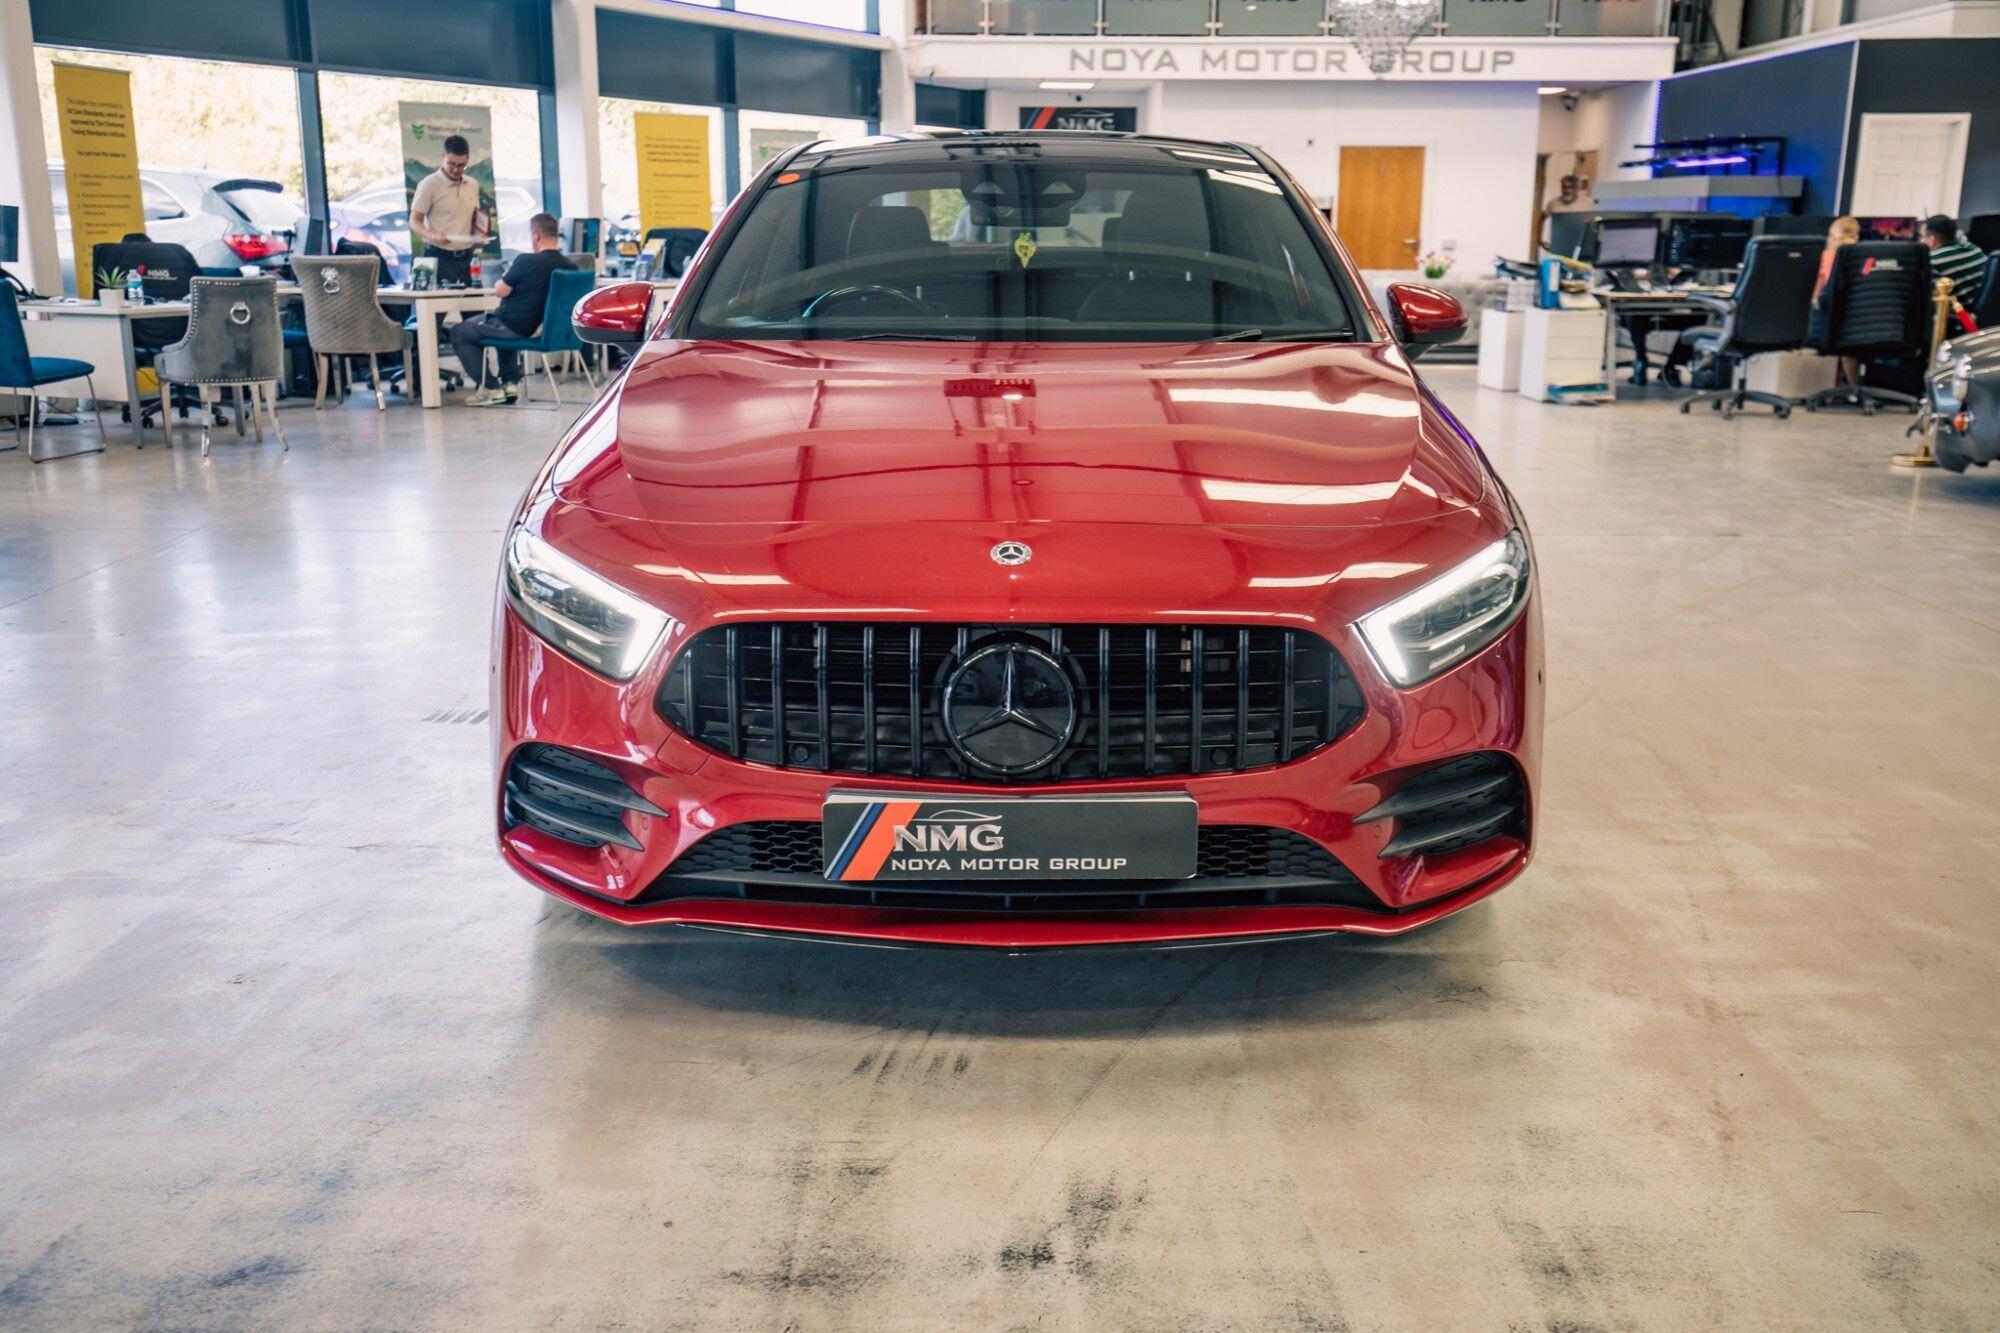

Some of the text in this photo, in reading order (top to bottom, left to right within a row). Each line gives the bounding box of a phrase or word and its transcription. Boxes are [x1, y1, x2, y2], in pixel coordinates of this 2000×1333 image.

[1070, 49, 1179, 71] NOYA
[1201, 49, 1348, 72] MOTOR
[1057, 117, 1115, 131] NMG
[892, 824, 1005, 852] NMG
[891, 858, 1127, 871] NOYA MOTOR GROUP
